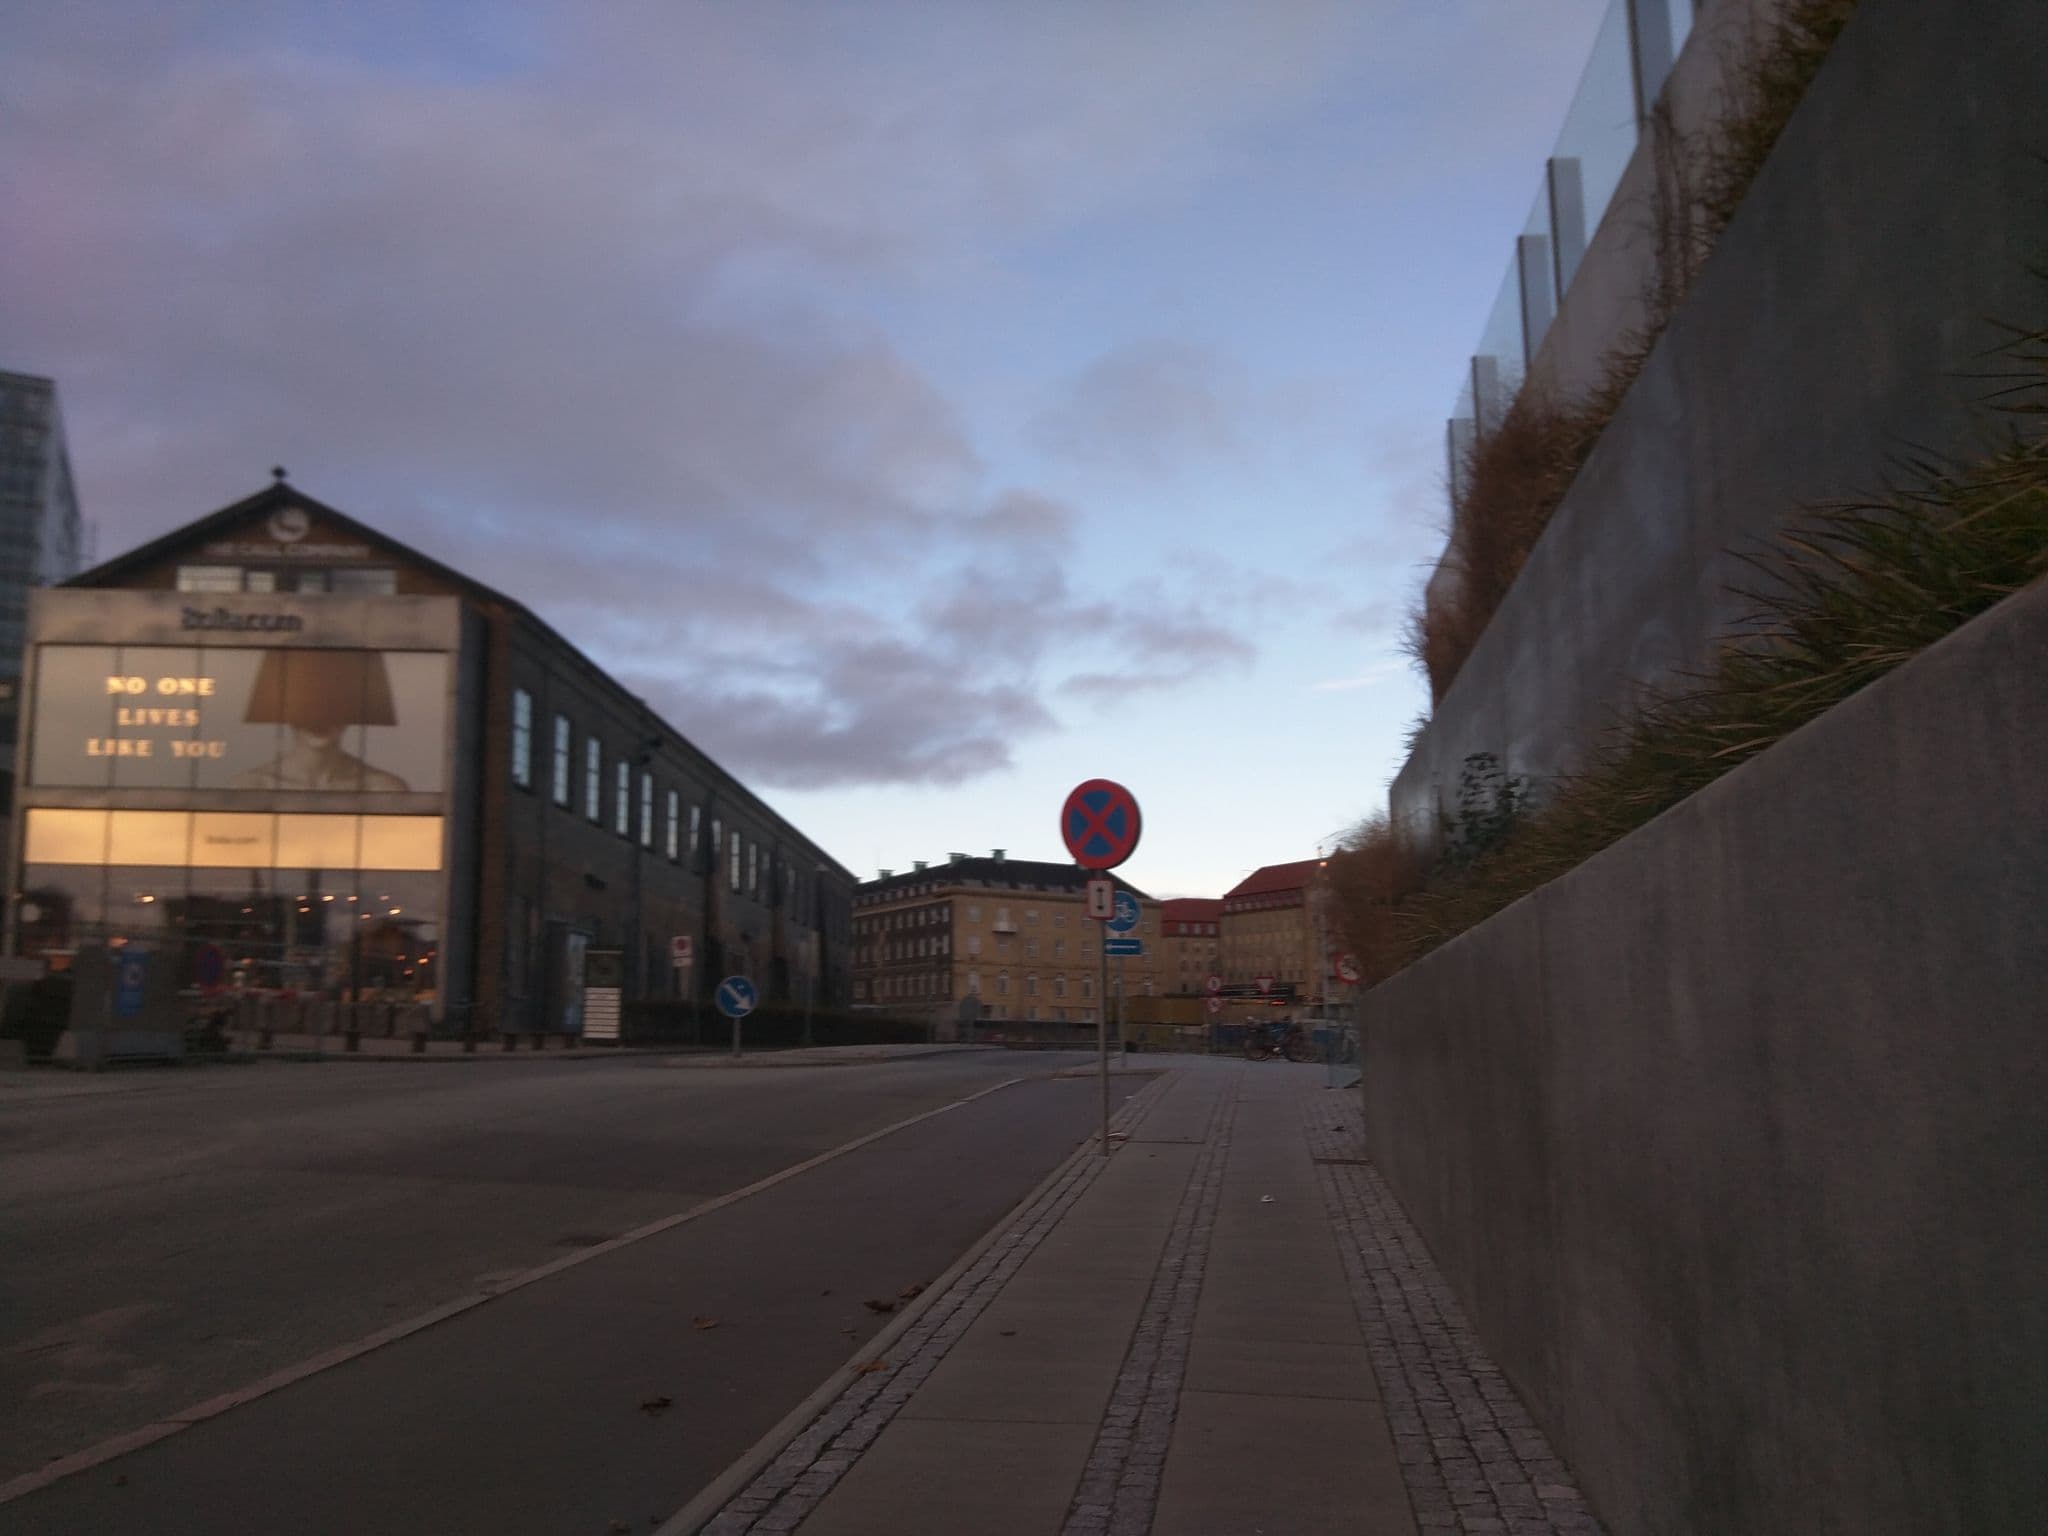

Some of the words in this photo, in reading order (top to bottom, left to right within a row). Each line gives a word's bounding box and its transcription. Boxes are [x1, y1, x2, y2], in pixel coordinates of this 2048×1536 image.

[106, 676, 147, 695] NO
[157, 677, 216, 696] ONE
[117, 707, 200, 726] LIVES
[87, 738, 154, 757] LIKE
[171, 740, 226, 758] YOU
